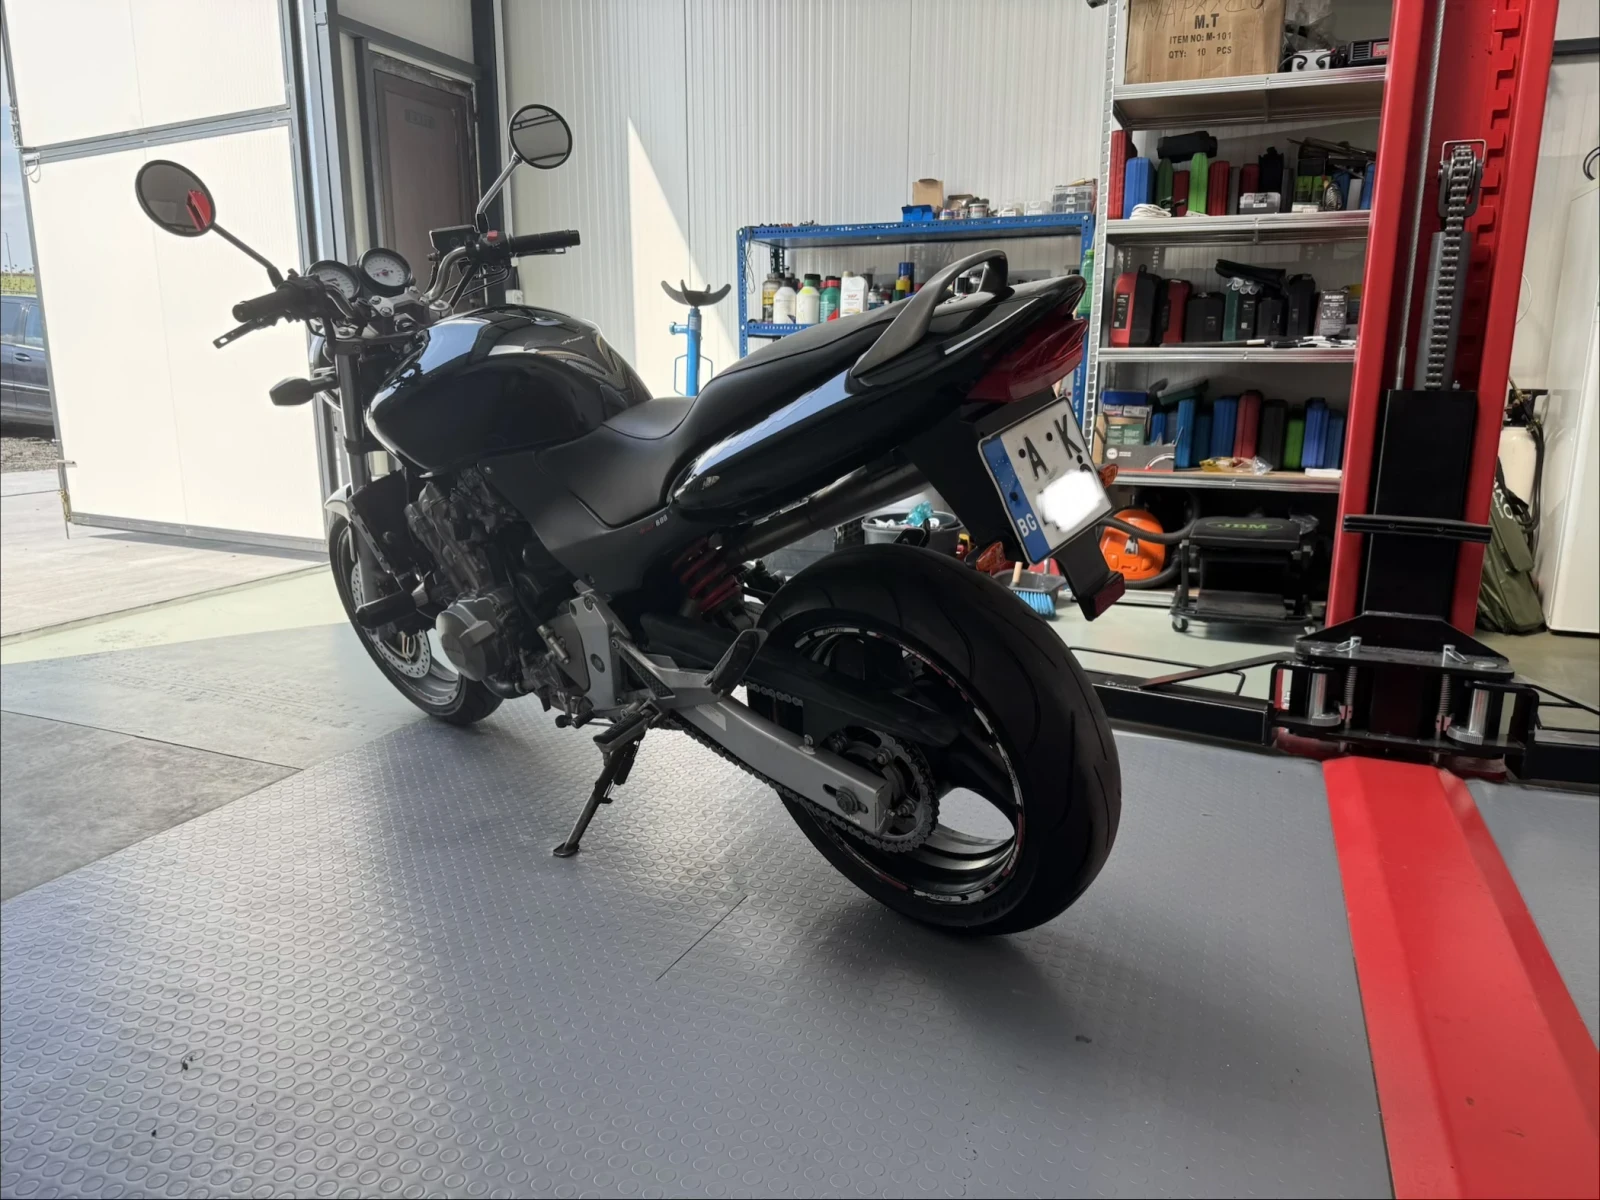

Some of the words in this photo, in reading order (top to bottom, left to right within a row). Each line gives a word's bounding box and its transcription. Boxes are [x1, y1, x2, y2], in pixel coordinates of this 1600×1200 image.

[1194, 13, 1220, 29] M.T
[1169, 35, 1189, 45] ITEM
[1190, 33, 1205, 43] NO:
[1205, 32, 1232, 42] M-101
[1168, 50, 1187, 59] QTY:
[1197, 47, 1207, 57] 10
[1216, 46, 1232, 55] PCS
[1017, 513, 1038, 538] BG
